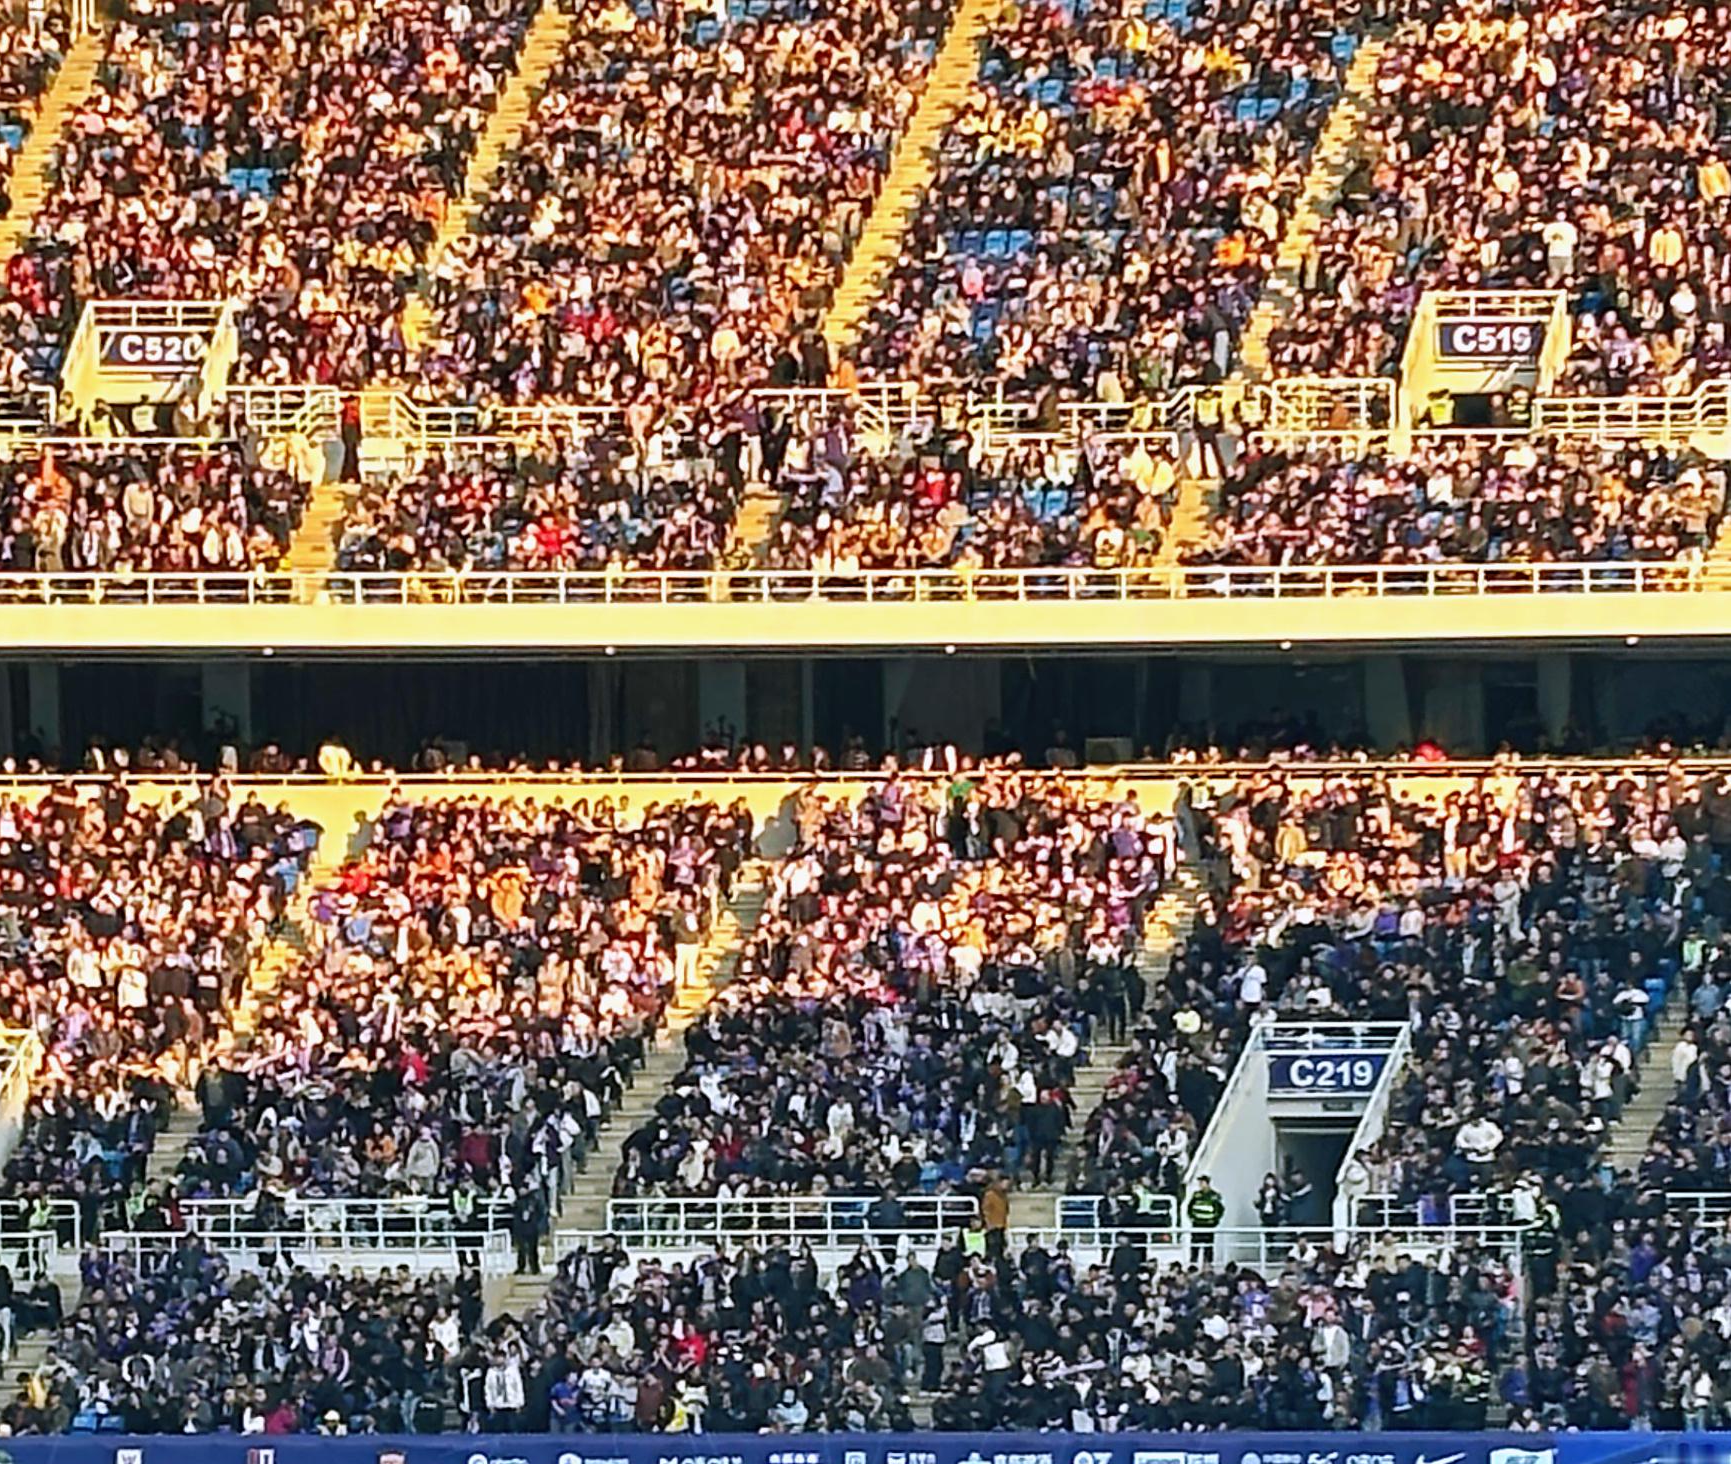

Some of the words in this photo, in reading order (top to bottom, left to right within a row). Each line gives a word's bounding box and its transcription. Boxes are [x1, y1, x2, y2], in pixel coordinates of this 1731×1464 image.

[120, 334, 203, 362] C520
[1452, 324, 1532, 353] C519
[1289, 1059, 1374, 1087] C219
